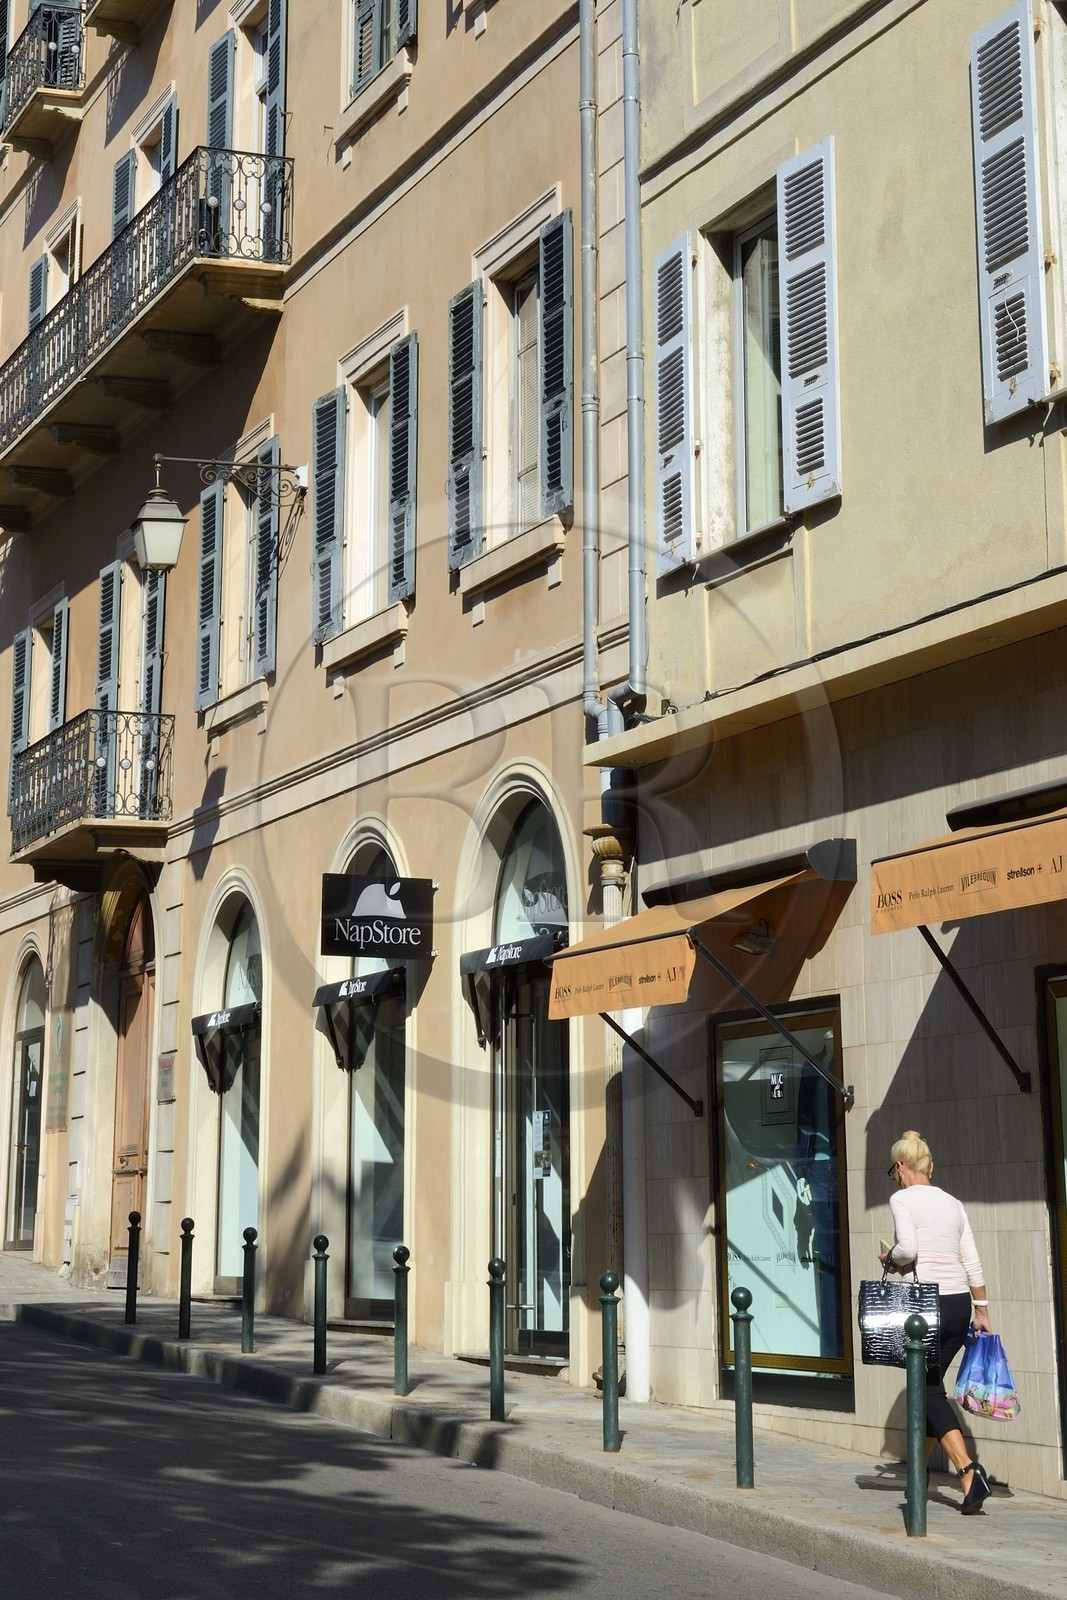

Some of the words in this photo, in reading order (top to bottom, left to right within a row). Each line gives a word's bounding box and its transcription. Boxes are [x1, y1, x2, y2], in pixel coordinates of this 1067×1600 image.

[877, 889, 903, 909] BOSS
[920, 886, 937, 900] Ralph
[936, 882, 955, 896] Lauren
[960, 869, 997, 892] VILEBREQUIN
[1006, 866, 1035, 881] strellson
[1049, 854, 1064, 875] AJ
[334, 918, 422, 950] NapStore
[554, 984, 572, 1000] BOSS
[665, 966, 677, 983] AJ
